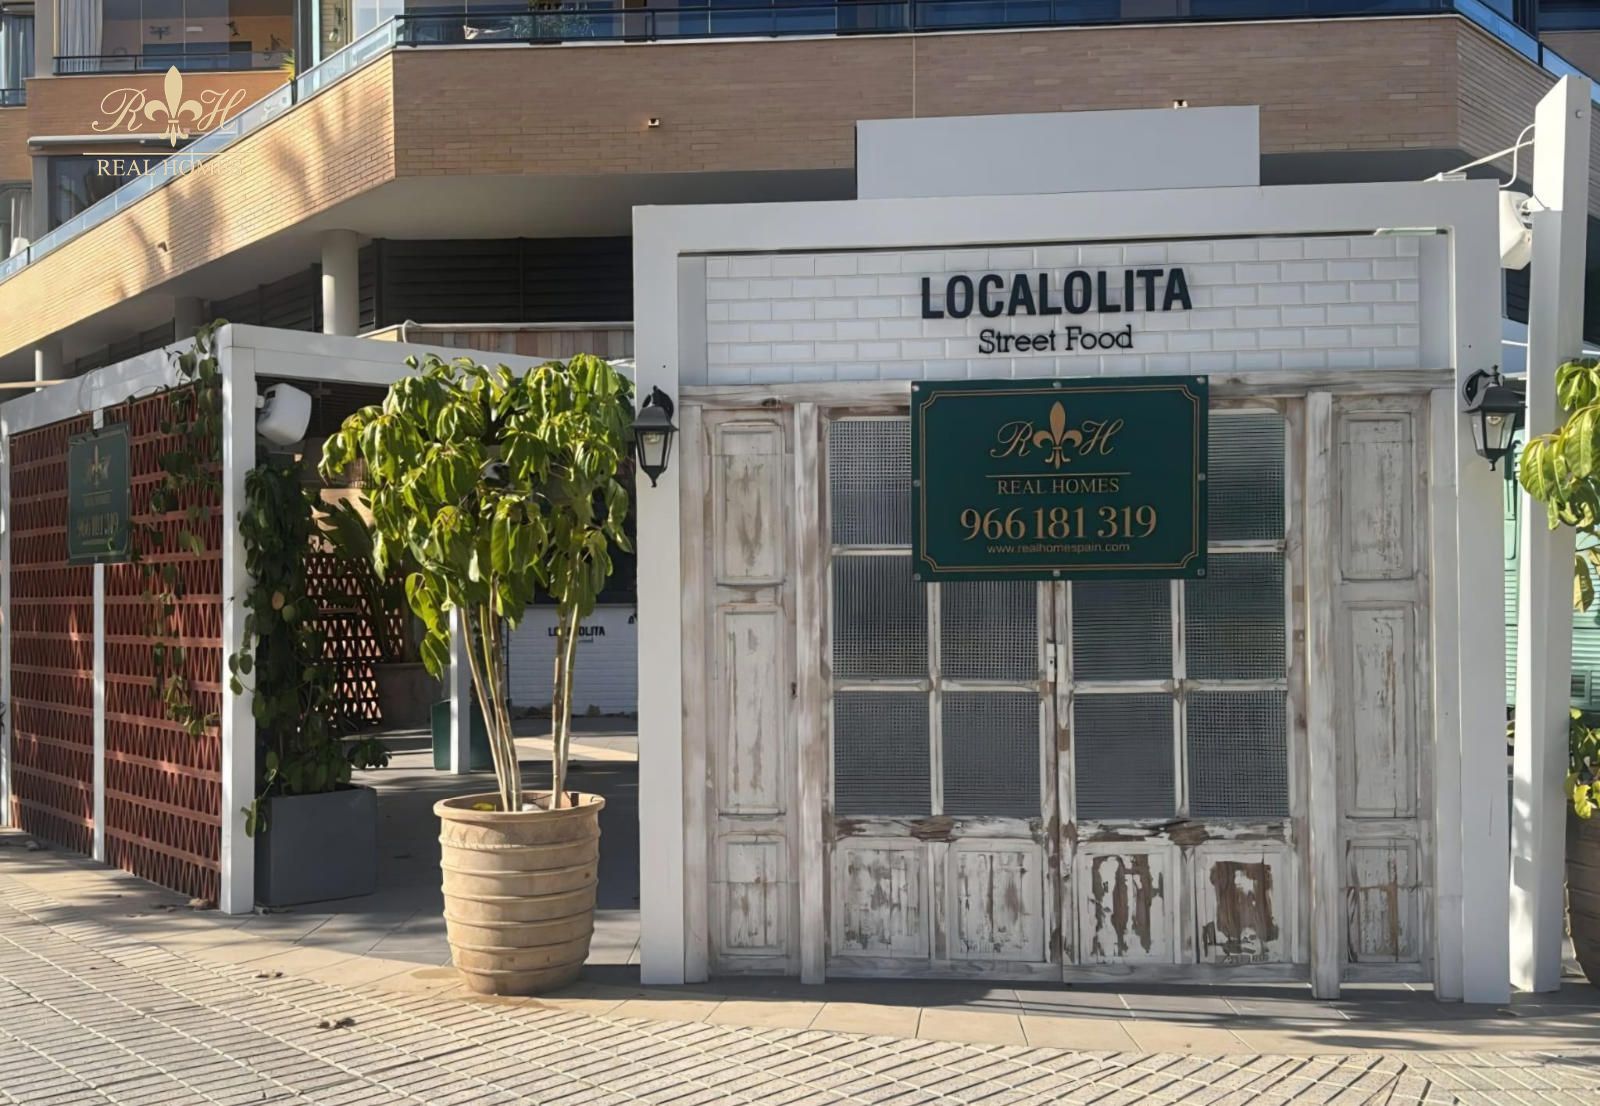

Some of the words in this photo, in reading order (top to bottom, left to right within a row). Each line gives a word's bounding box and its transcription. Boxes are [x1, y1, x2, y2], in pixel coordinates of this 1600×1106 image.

[921, 267, 1193, 320] LOCALOLITA
[978, 328, 1057, 354] Street
[1065, 324, 1134, 351] Food
[997, 479, 1048, 495] REAL
[1052, 477, 1120, 494] HOMES
[960, 506, 1026, 541] 966
[1032, 505, 1086, 540] 181
[1097, 504, 1158, 539] 319
